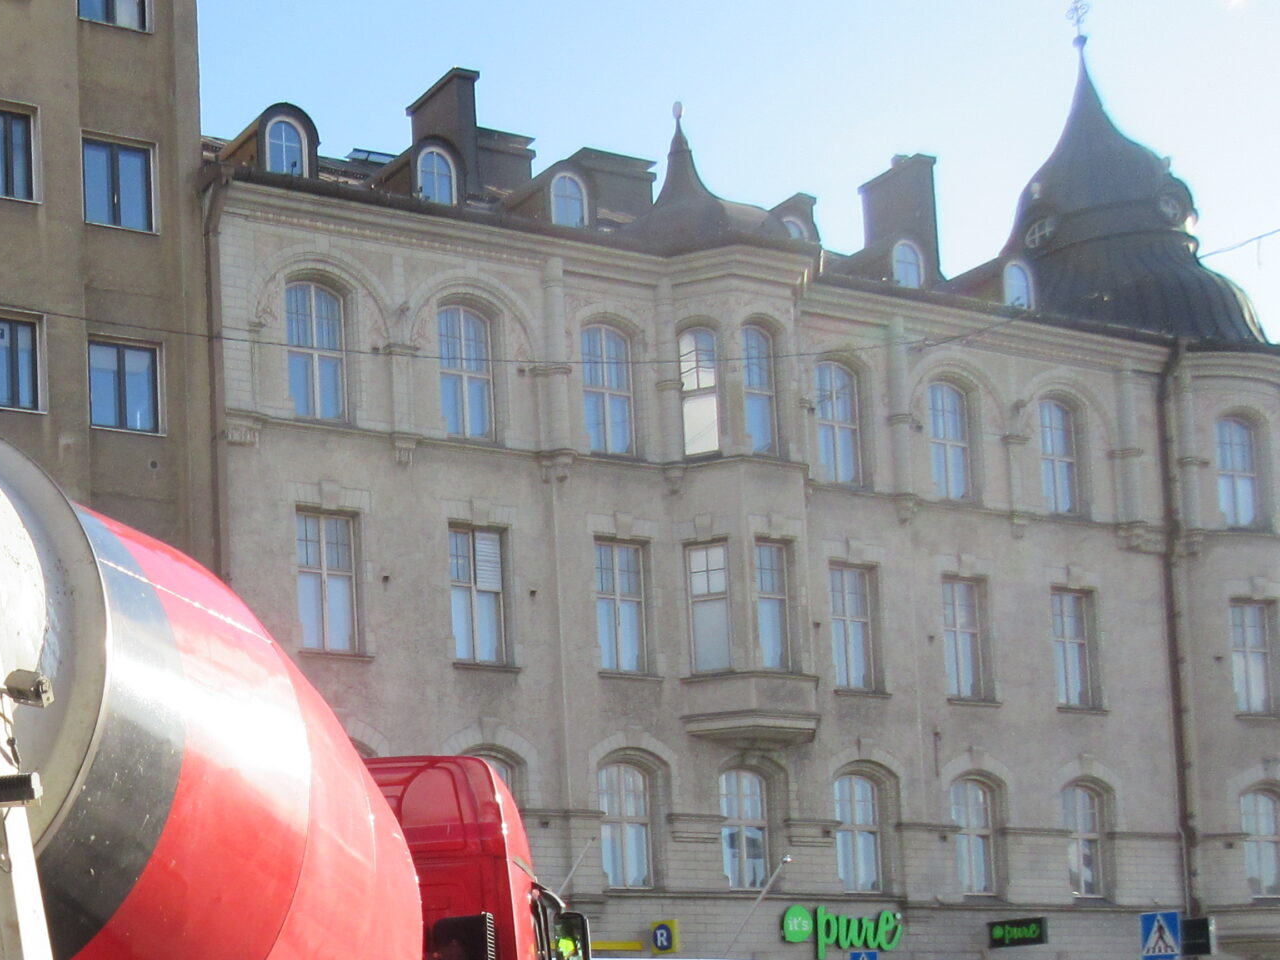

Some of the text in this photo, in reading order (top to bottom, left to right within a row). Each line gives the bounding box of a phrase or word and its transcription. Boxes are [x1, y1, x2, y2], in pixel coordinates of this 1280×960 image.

[655, 929, 668, 946] R
[787, 904, 903, 960] it's pure
[1004, 923, 1040, 944] pure
